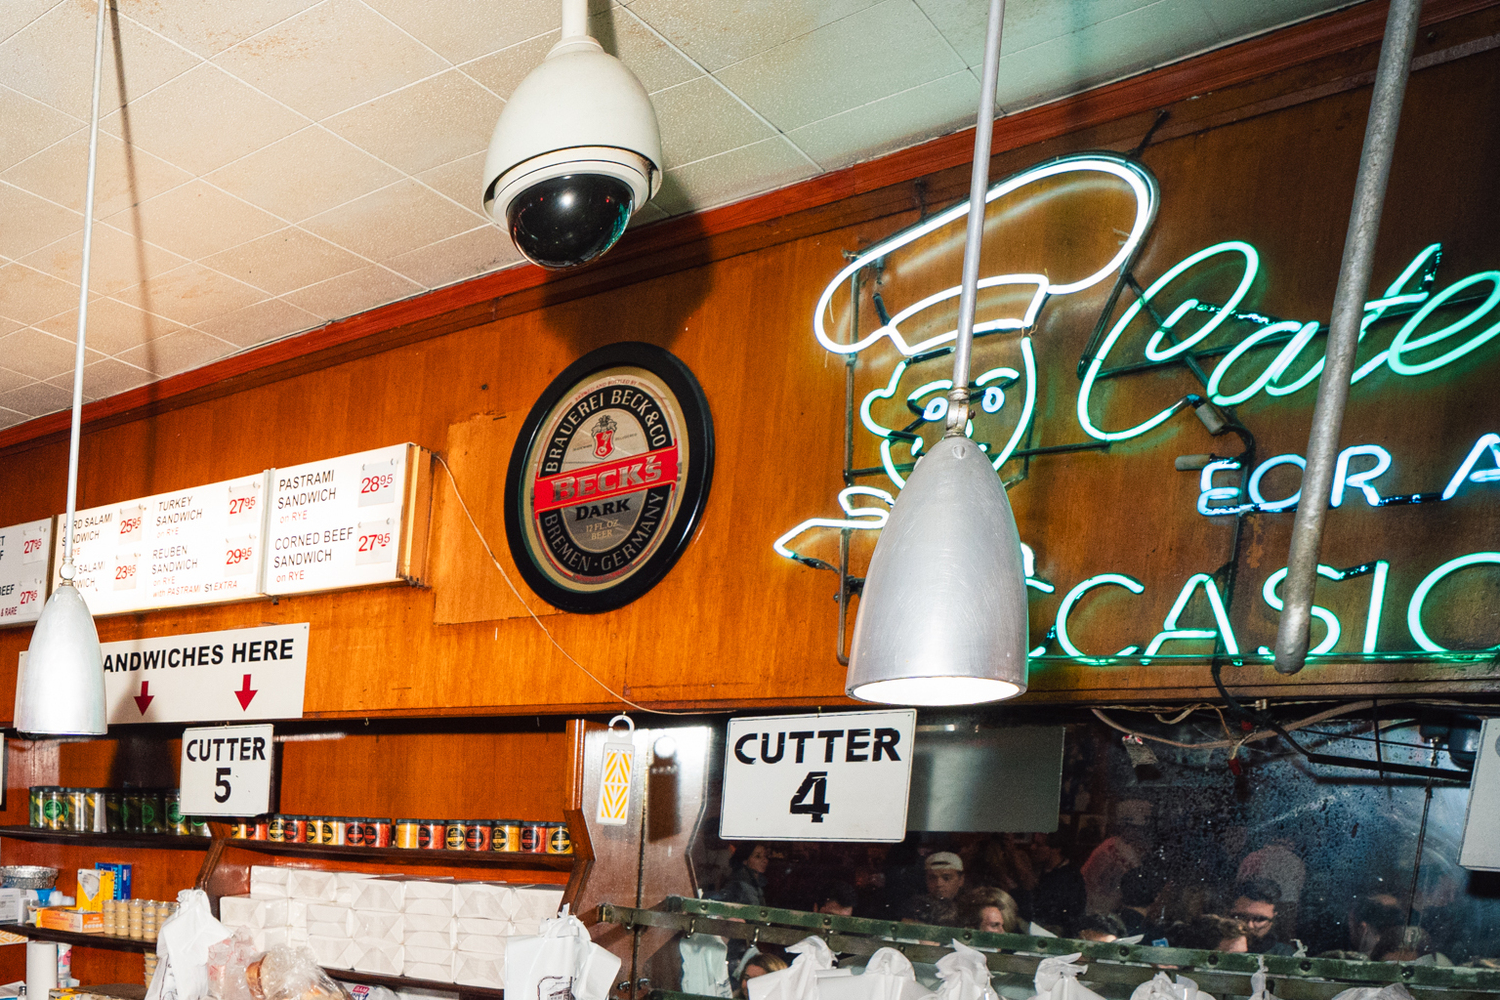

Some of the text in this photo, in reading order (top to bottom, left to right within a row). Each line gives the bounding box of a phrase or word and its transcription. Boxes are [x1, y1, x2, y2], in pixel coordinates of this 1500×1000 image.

[1078, 240, 1500, 442] Cate
[545, 393, 604, 472] BRAUEREI
[279, 469, 335, 492] PASTRAMI
[158, 496, 193, 512] TURKEY
[277, 487, 337, 510] SANDWICH
[156, 508, 203, 527] SANDWICH
[280, 510, 308, 524] on RYE
[575, 498, 631, 522] DARK
[63, 518, 83, 532] HRD
[84, 513, 113, 526] SALAMI
[166, 527, 179, 536] RYE
[544, 492, 664, 571] BREMEN GERMANY
[62, 530, 100, 546] SNDWICH
[275, 532, 320, 550] CORNED
[324, 527, 354, 543] BEEF
[591, 530, 613, 540] BEER
[152, 545, 188, 560] REUBEN
[274, 549, 332, 569] SANDWICH
[79, 561, 105, 575] SALAMI
[152, 559, 198, 575] SANDWICH
[276, 570, 305, 582] on RYE
[153, 580, 238, 598] with PASTRAMI EXTRA
[162, 576, 175, 585] RYE
[5, 606, 18, 615] RARE
[103, 638, 294, 673] ANDWICHES HERE
[186, 736, 266, 762] CUTTER
[733, 728, 902, 765] CUTTER
[213, 767, 232, 803] 5
[789, 770, 831, 825] 4
